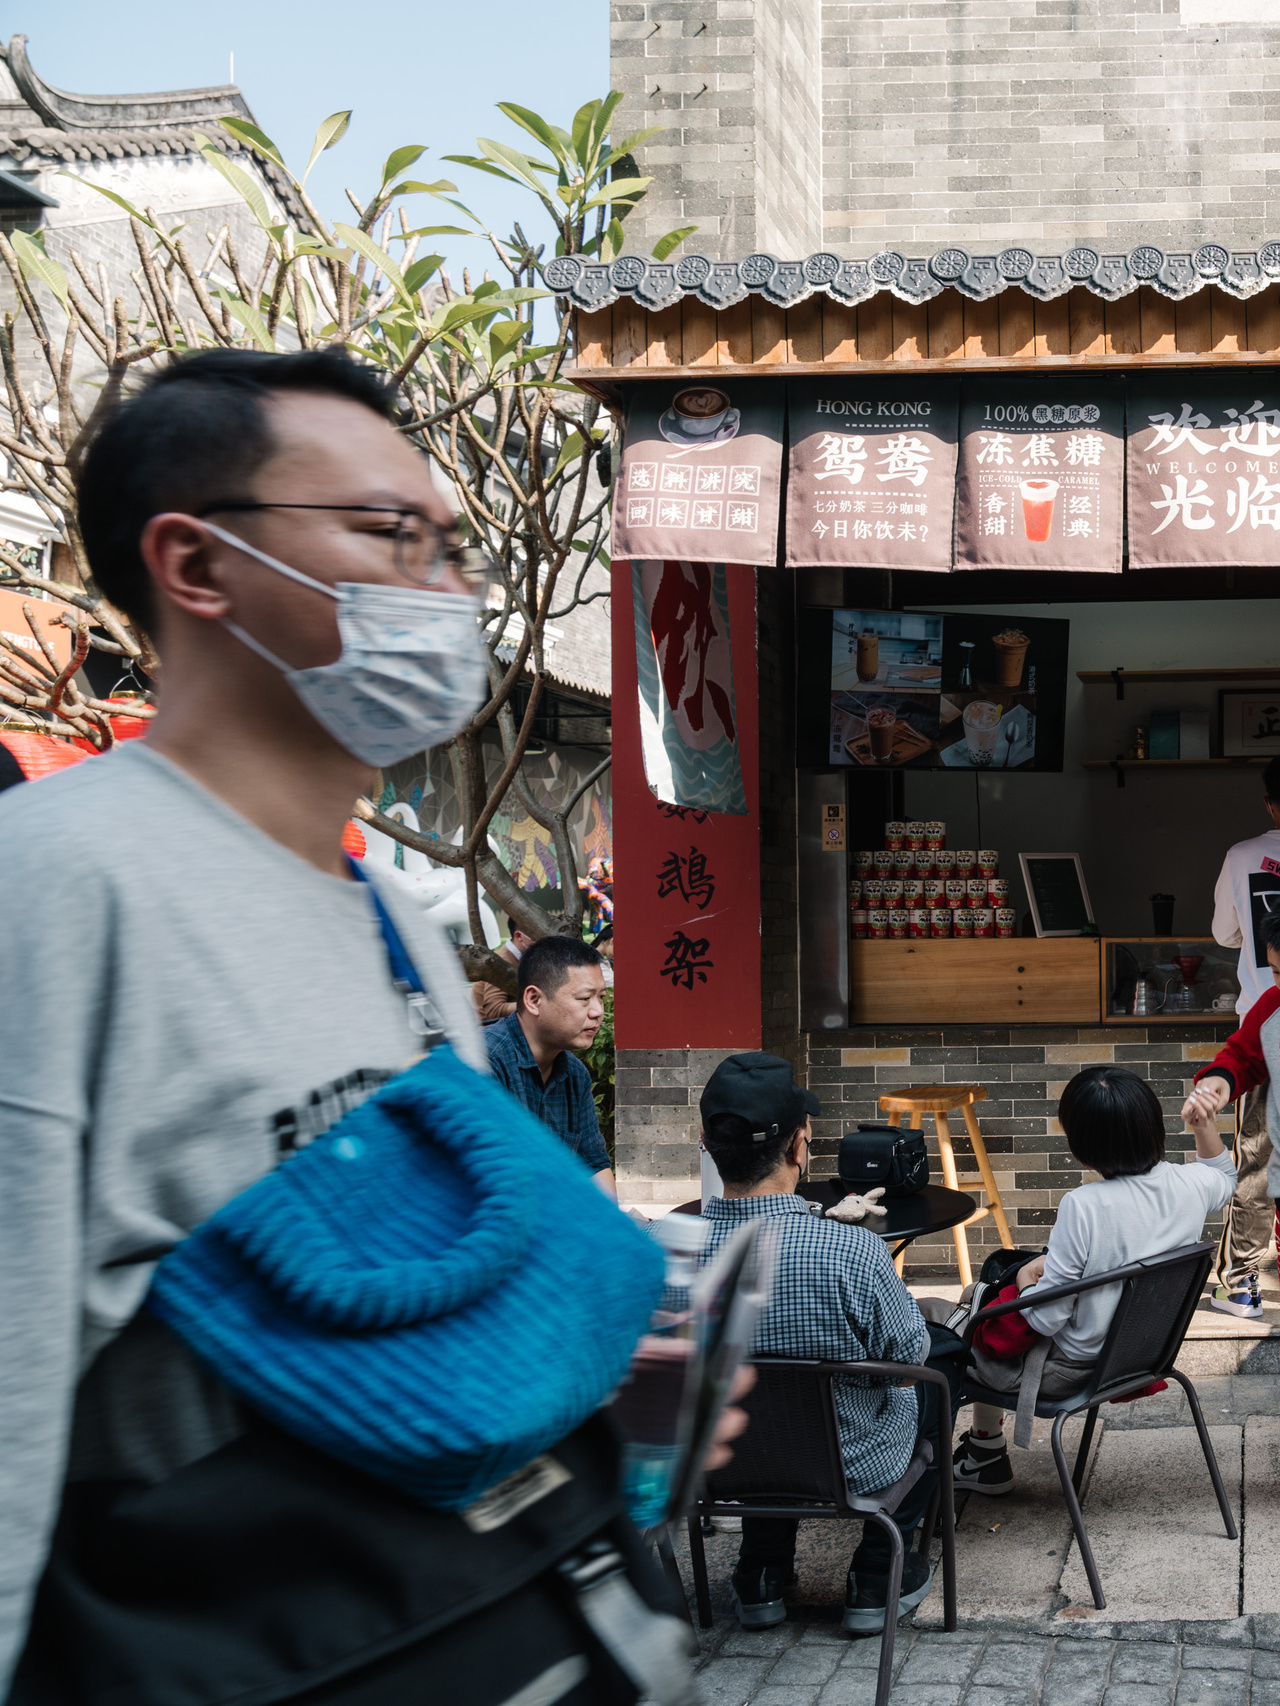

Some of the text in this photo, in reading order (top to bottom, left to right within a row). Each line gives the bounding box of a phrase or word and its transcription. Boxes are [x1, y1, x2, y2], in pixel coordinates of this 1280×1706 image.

[816, 399, 932, 416] HONG KONG
[983, 404, 1100, 423] 100% 黑糖原浆
[812, 434, 935, 487] 鸳鸯
[975, 434, 1106, 467] 冻焦糖
[629, 464, 759, 494] 选料讲究
[979, 475, 1100, 485] ICE-COLD CARAMEL
[1145, 461, 1280, 476] WELCOME
[628, 501, 757, 529] 回味甘甜
[812, 499, 928, 516] 七分奶茶 三分咖啡
[982, 492, 1008, 536] 香甜
[1066, 495, 1094, 538] 经典
[656, 803, 716, 991] 鵡架
